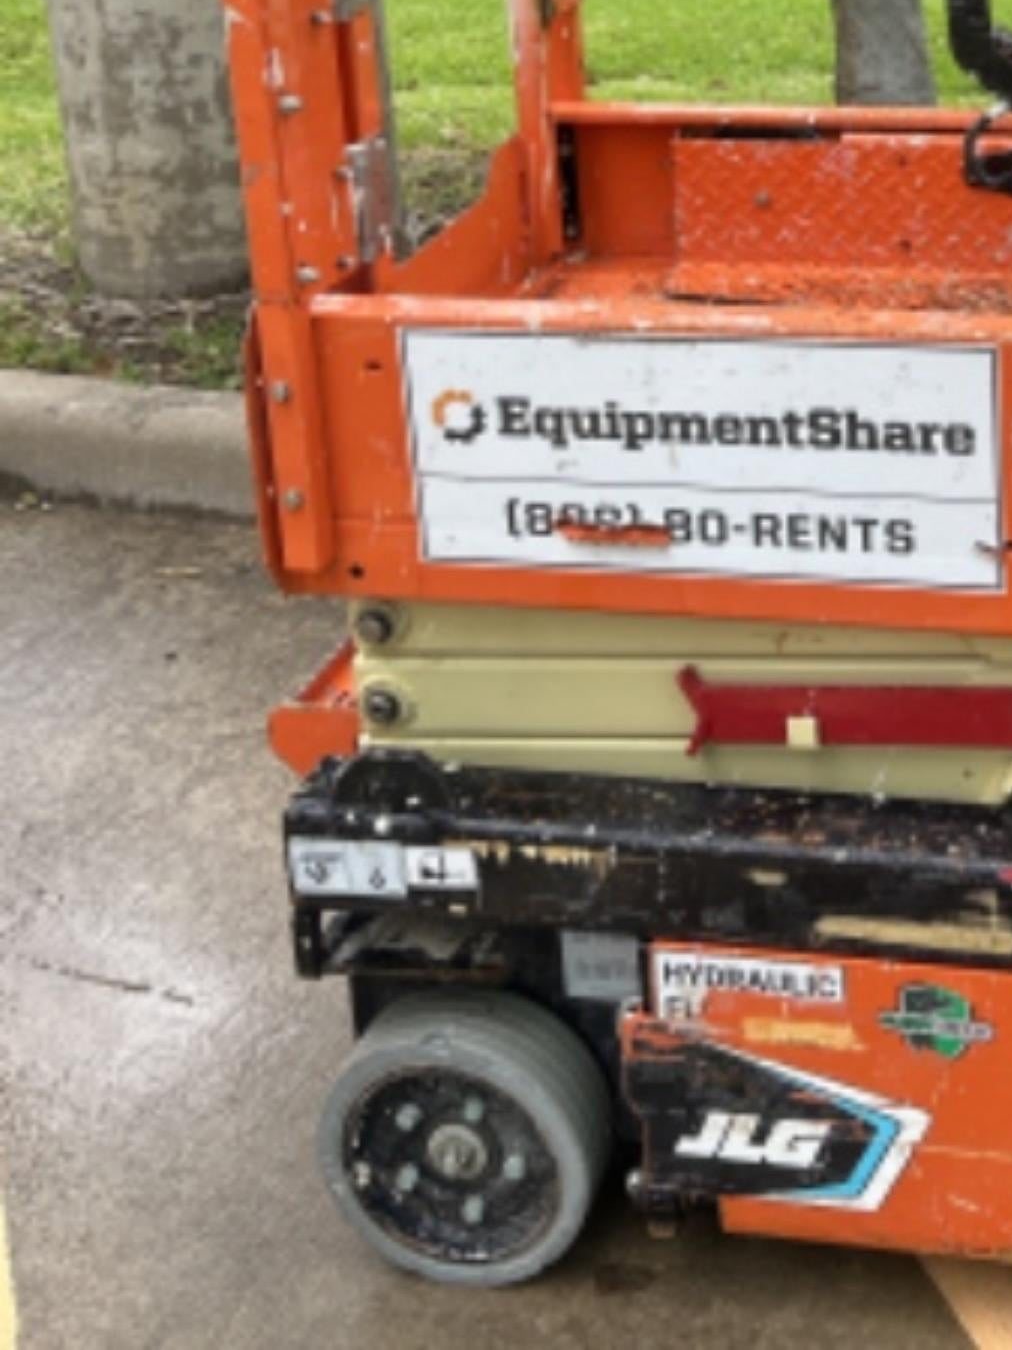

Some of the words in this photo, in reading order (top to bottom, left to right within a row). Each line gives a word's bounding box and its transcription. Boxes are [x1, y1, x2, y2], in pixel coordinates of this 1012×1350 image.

[496, 395, 977, 456] EquipmentShare
[663, 507, 916, 554] 80-RENTS
[662, 961, 838, 998] HYDRAULIC
[674, 1111, 832, 1169] JLG
